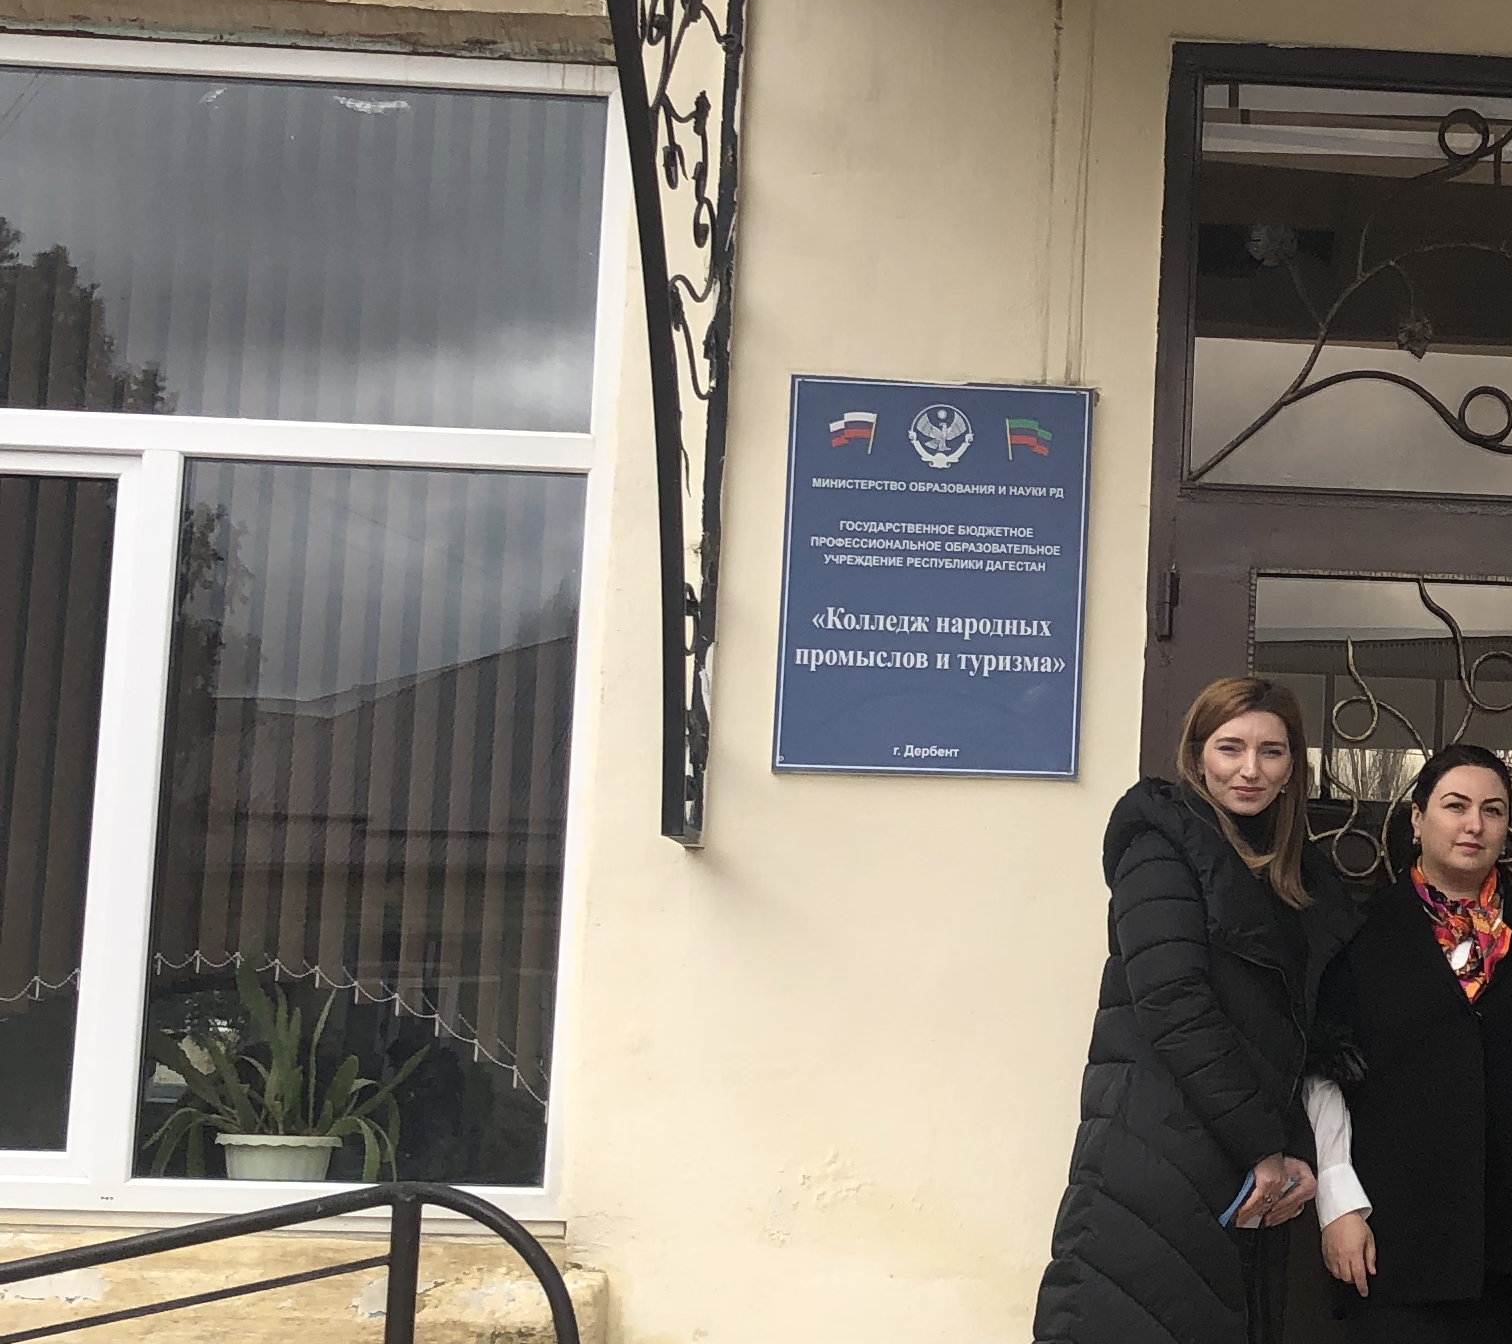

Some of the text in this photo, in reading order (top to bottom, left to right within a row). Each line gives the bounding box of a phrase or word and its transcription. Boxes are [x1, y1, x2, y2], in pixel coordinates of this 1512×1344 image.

[812, 478, 1064, 499] МИНИСТЕРСТВО ОБРАЗОВАНИЯ И НАУКИ РД
[840, 521, 1033, 538] ГОСУДАРСТВЕННОЕ БЮДЖЕТНОЕ
[811, 536, 1060, 555] ПРОФЕССИОНАЛЬНОЕ ОБРАЗОВАТЕЛЬНОЕ
[824, 554, 1046, 573] УЧРЕЖДЕНИЕ РЕСПУБЛИКИ ДАГЕСТАН
[812, 607, 1051, 640] «Колледж народных
[795, 648, 1065, 677] промыслов и туризма»
[893, 747, 901, 755] г.
